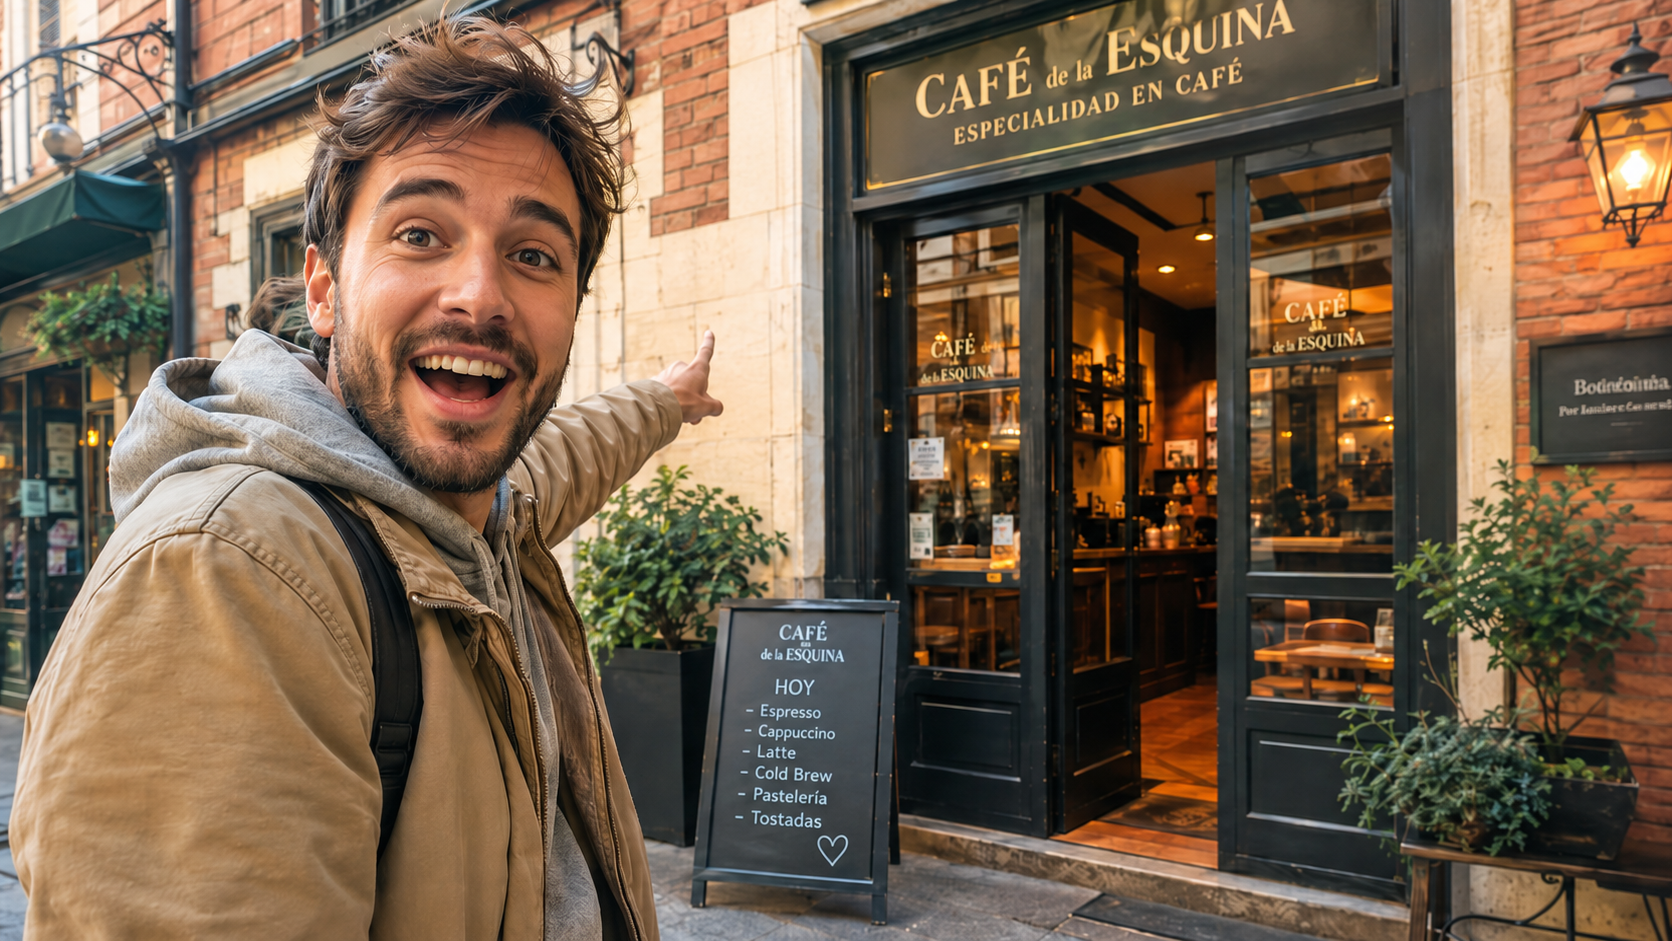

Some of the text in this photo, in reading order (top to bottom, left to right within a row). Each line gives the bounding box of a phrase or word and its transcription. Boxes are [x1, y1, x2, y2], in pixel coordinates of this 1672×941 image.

[915, 0, 1296, 119] CAFÉ de la ESQUINA
[953, 57, 1243, 145] ESPECIALIDAD EN CAFÉ
[1284, 292, 1347, 323] CAFÉ
[931, 332, 976, 358] CAFÉ
[1272, 331, 1365, 353] de la ESQUINA
[941, 365, 994, 383] ESQUINA
[779, 620, 827, 641] CAFÉ
[760, 648, 845, 664] de la ESQUINA
[775, 678, 815, 696] HOY
[760, 703, 821, 721] Espresso
[758, 724, 836, 741] Cappuccino
[757, 744, 796, 759] Latte
[755, 765, 788, 780] Cold
[794, 767, 832, 782] Brew
[753, 787, 828, 805] Pastelería
[751, 810, 822, 828] Tostadas
